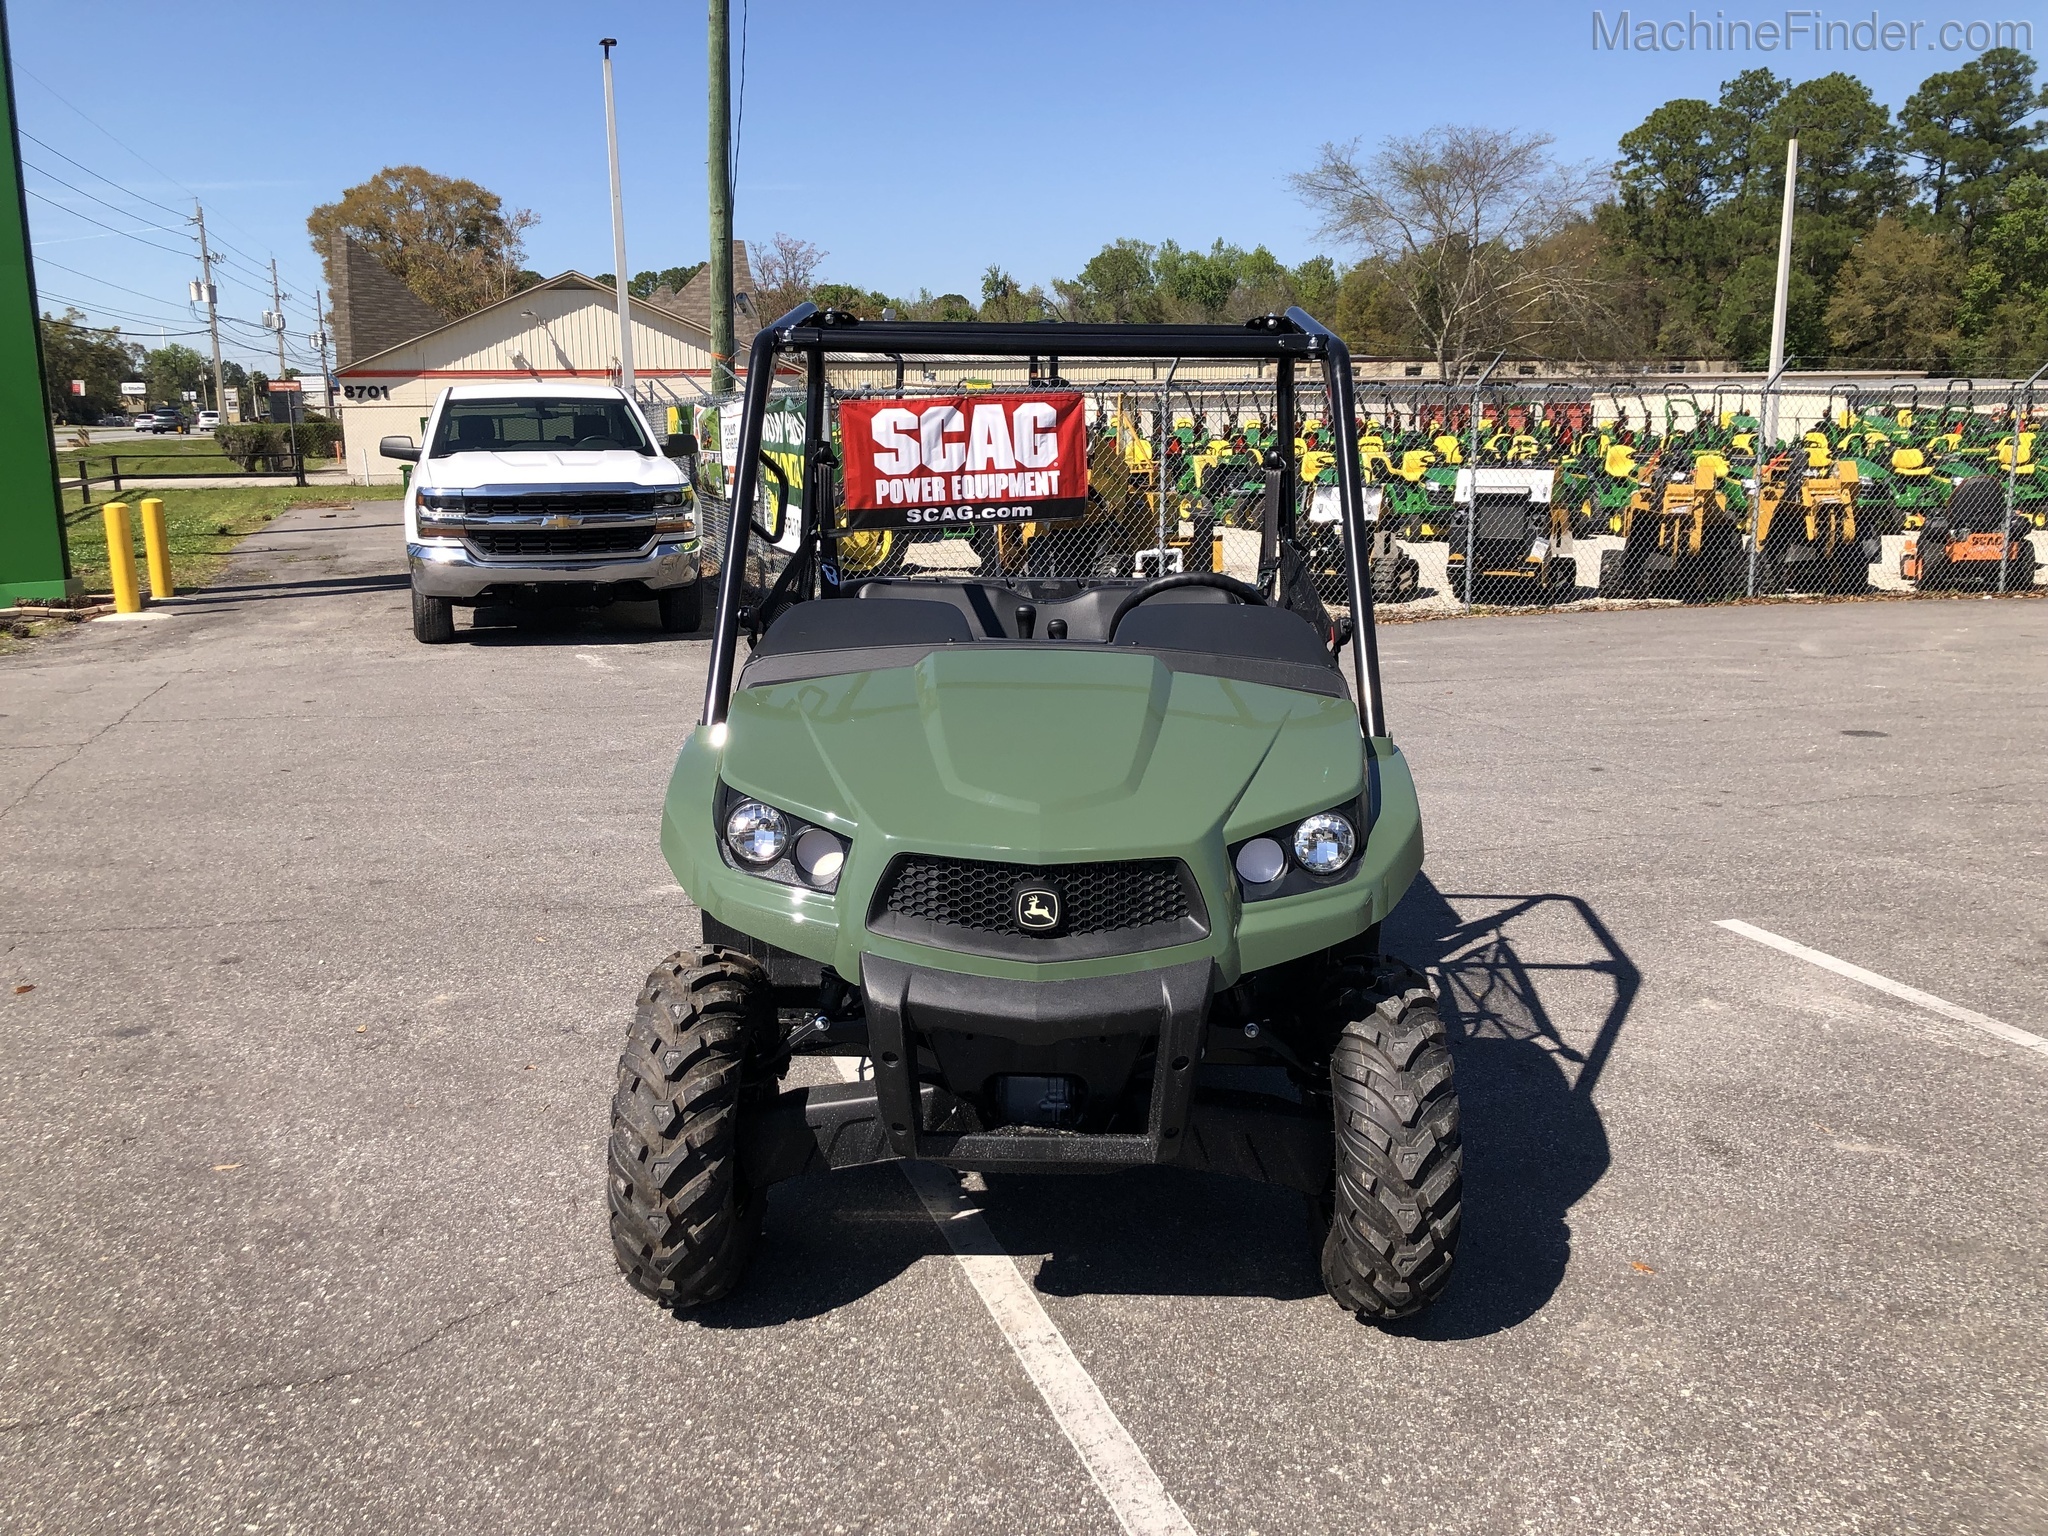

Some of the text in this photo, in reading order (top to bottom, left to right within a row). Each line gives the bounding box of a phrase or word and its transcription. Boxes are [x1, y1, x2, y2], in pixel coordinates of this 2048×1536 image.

[344, 385, 387, 398] 8701
[870, 402, 1059, 476] SCAG
[875, 470, 1060, 505] POWER EQUIPMENT
[906, 504, 1032, 524] SCAG.com
